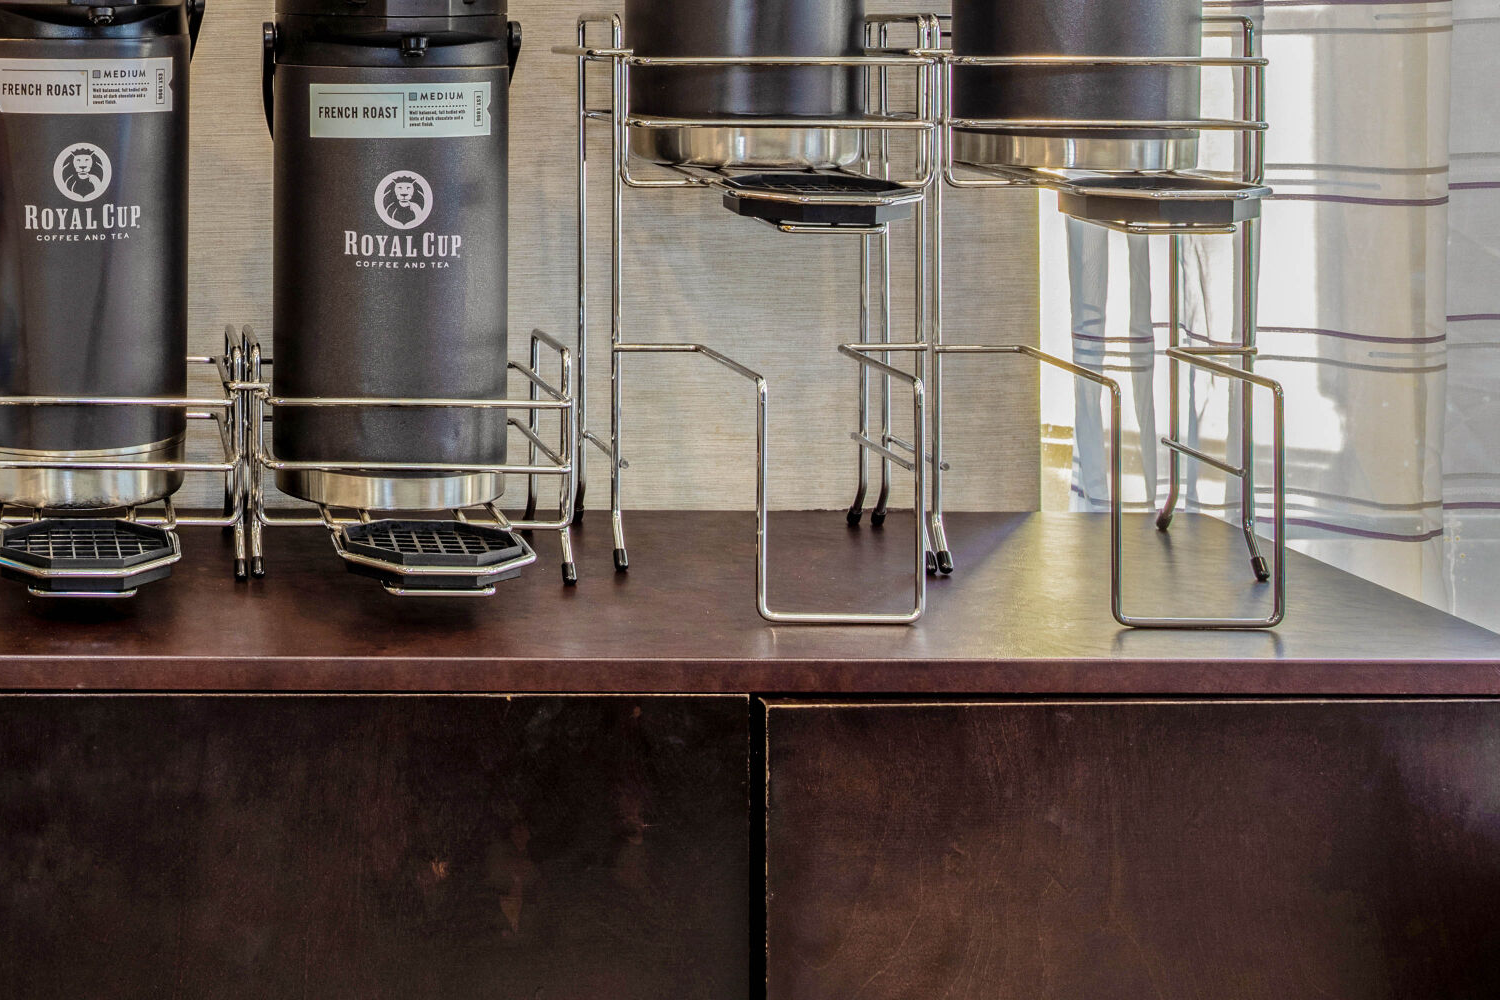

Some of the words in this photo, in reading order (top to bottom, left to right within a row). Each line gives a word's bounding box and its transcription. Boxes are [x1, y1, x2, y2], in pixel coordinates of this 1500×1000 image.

[103, 69, 146, 79] MEDIUM
[1, 83, 42, 96] FRENCH
[46, 83, 82, 97] ROAST
[420, 91, 464, 101] MEDIUM
[318, 106, 358, 119] FRENCH
[362, 106, 398, 119] ROAST
[24, 204, 98, 231] ROYAL
[102, 203, 141, 229] CUP
[84, 233, 107, 241] AND
[111, 232, 130, 240] TEA
[344, 230, 418, 257] ROYAL
[422, 231, 461, 258] CUP
[355, 260, 399, 268] COFFEE
[403, 261, 426, 269] AND
